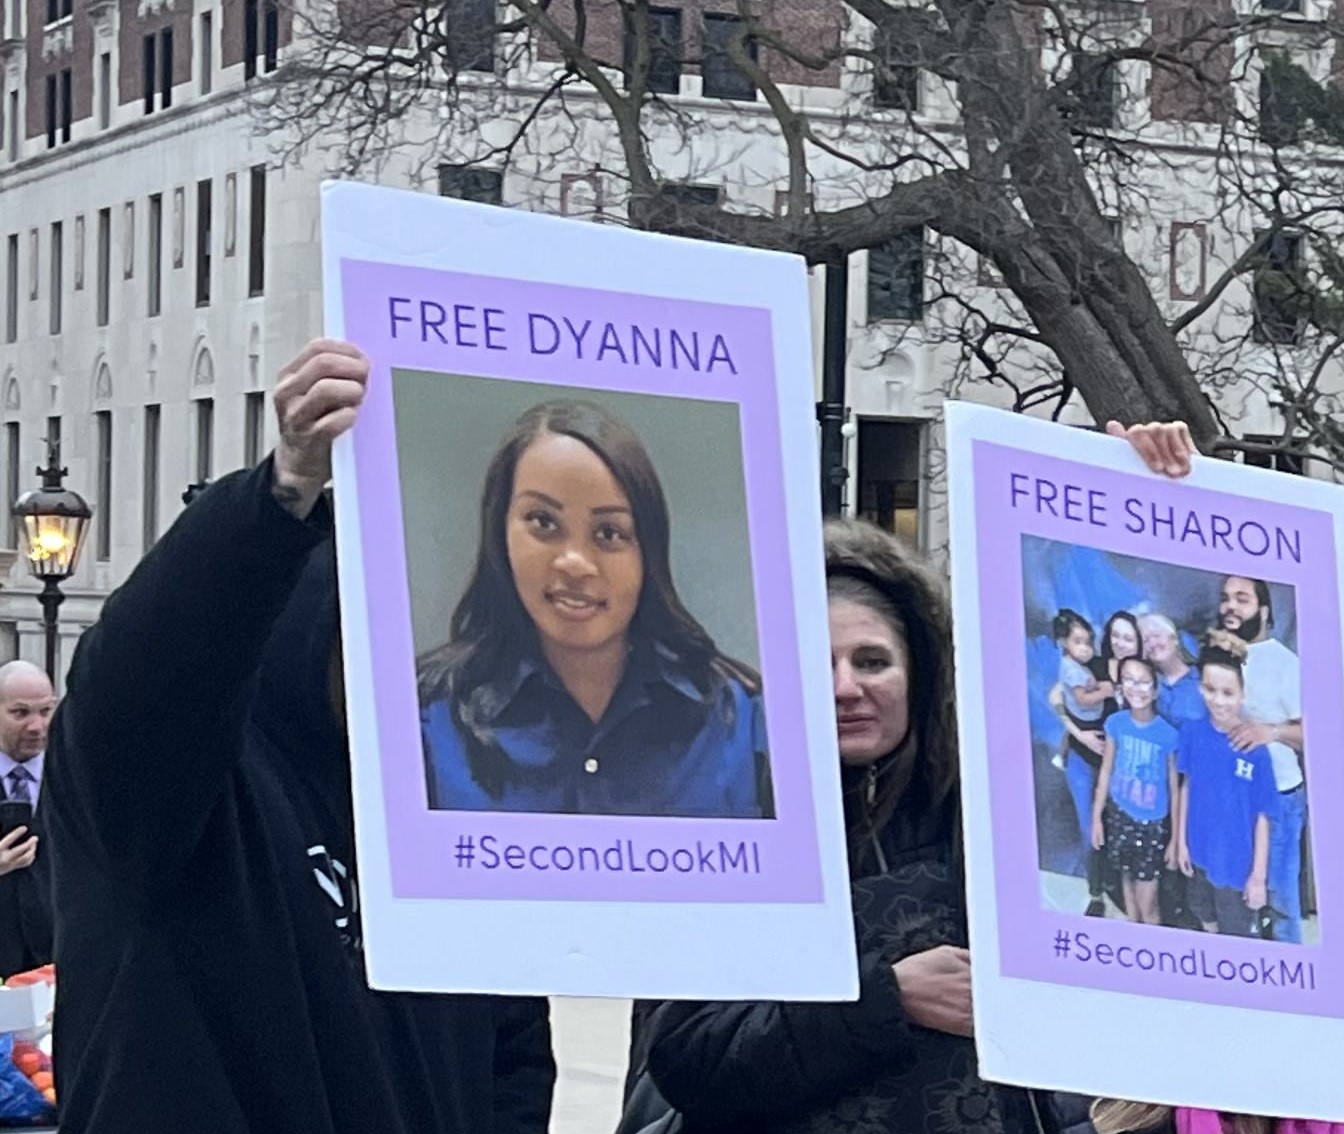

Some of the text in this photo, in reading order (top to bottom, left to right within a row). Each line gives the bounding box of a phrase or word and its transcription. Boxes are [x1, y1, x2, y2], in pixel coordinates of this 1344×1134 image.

[389, 297, 738, 375] FREE DYANNA
[1011, 472, 1302, 565] FREE SHARON
[454, 834, 761, 875] #SecondLookMI
[1054, 928, 1316, 991] #SecondLookMI
